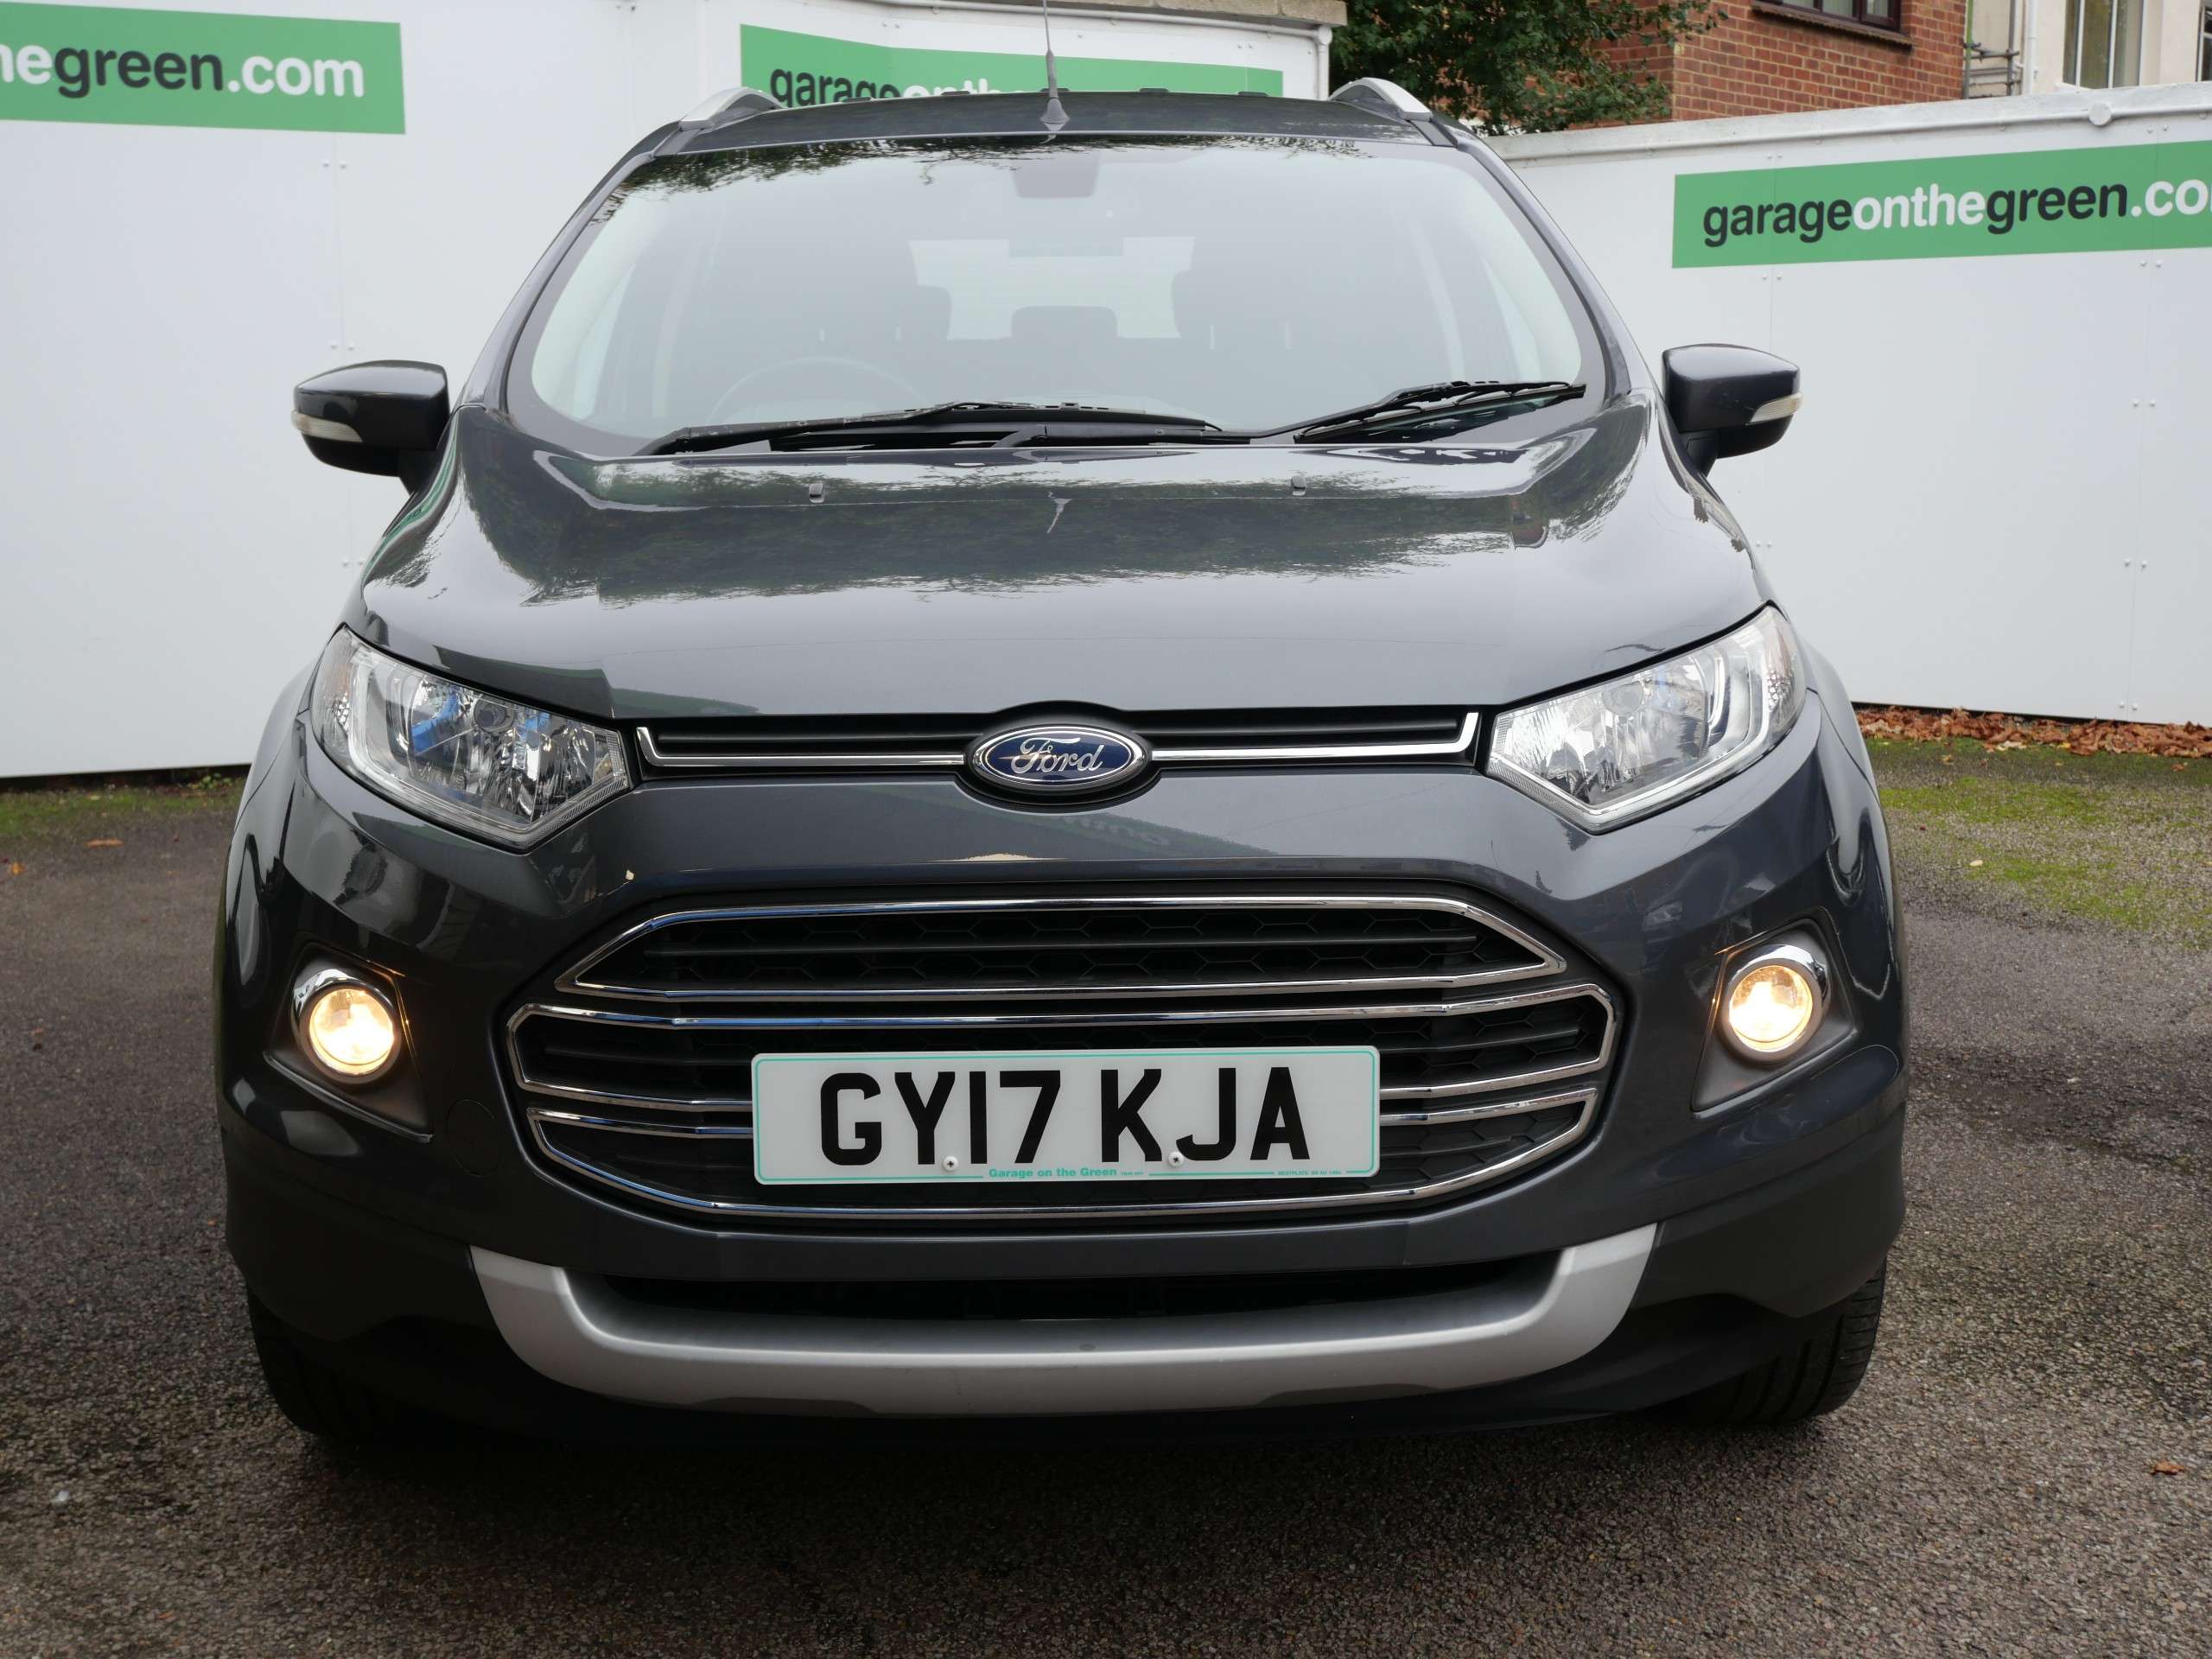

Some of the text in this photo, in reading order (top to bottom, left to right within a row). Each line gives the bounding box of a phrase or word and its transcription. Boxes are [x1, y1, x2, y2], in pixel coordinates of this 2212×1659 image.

[1703, 179, 2212, 248] garageonthegreen.co
[1011, 737, 1104, 774] Ford
[820, 1066, 1311, 1166] GY17 KJA
[988, 1168, 1033, 1179] Garage
[1038, 1169, 1052, 1178] on
[1057, 1167, 1077, 1177] the
[1080, 1167, 1117, 1177] Green
